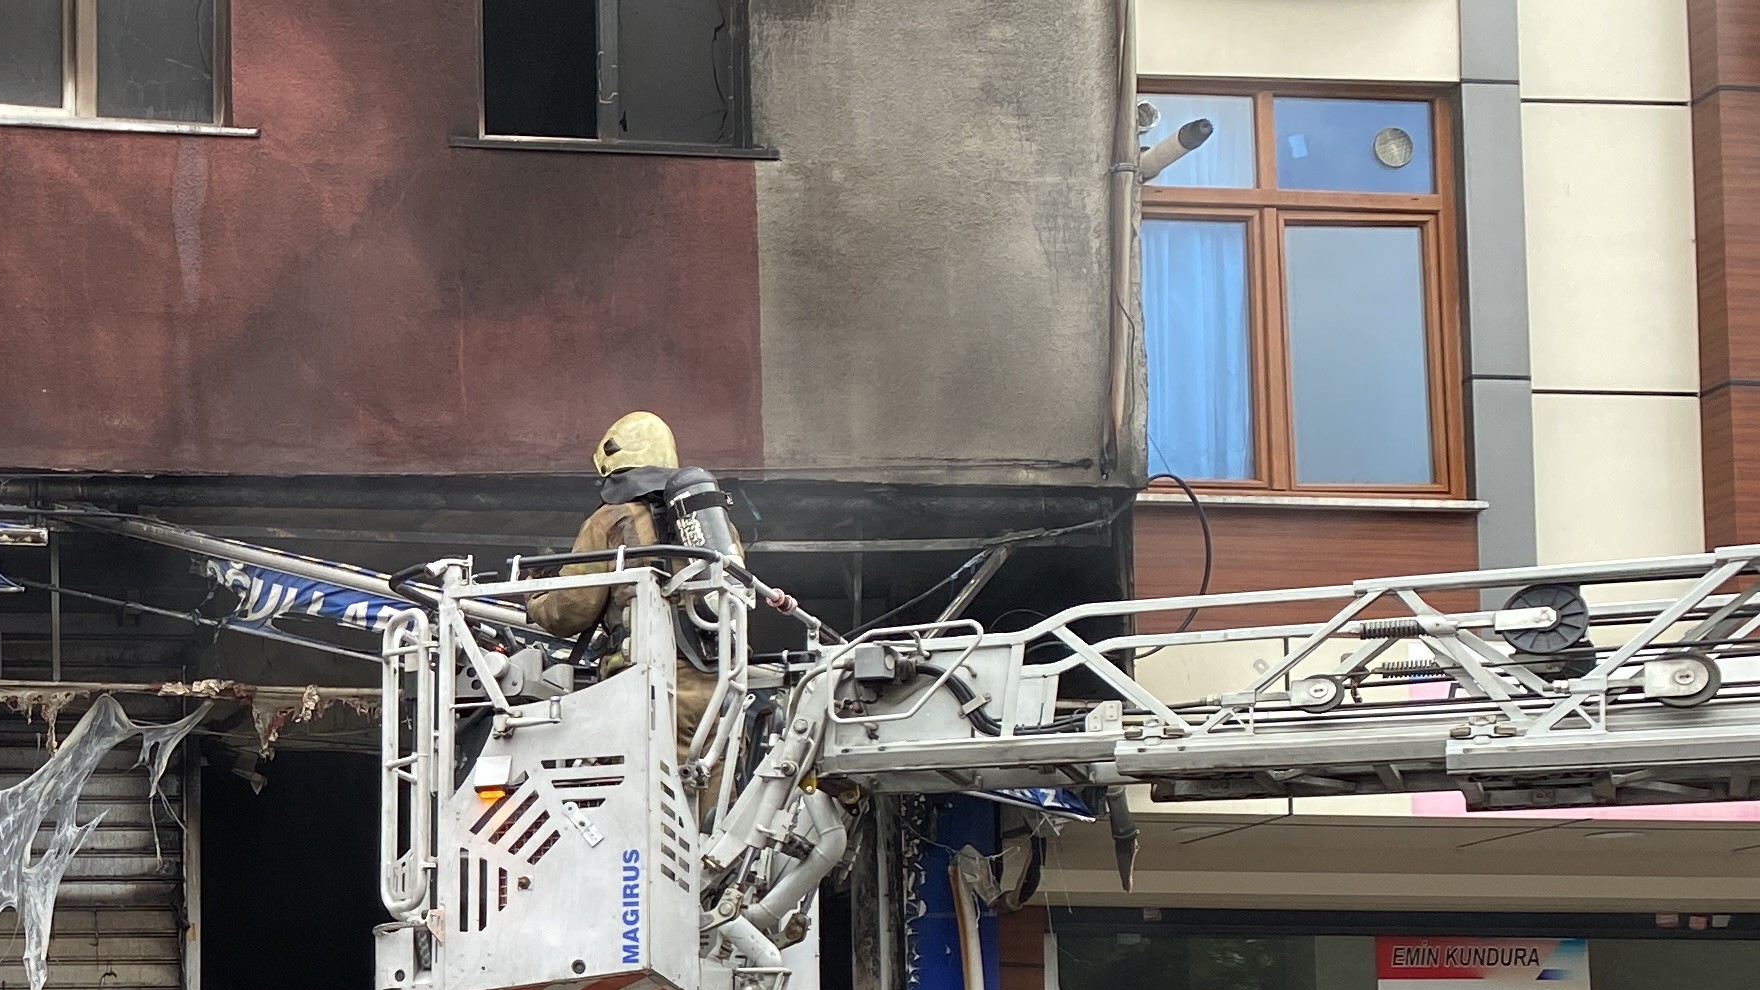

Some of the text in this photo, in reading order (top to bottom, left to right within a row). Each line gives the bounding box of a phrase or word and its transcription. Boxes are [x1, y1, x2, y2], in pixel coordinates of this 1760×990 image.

[622, 849, 640, 964] MAGIRUS
[1392, 940, 1540, 968] EMİN KUNDURA
